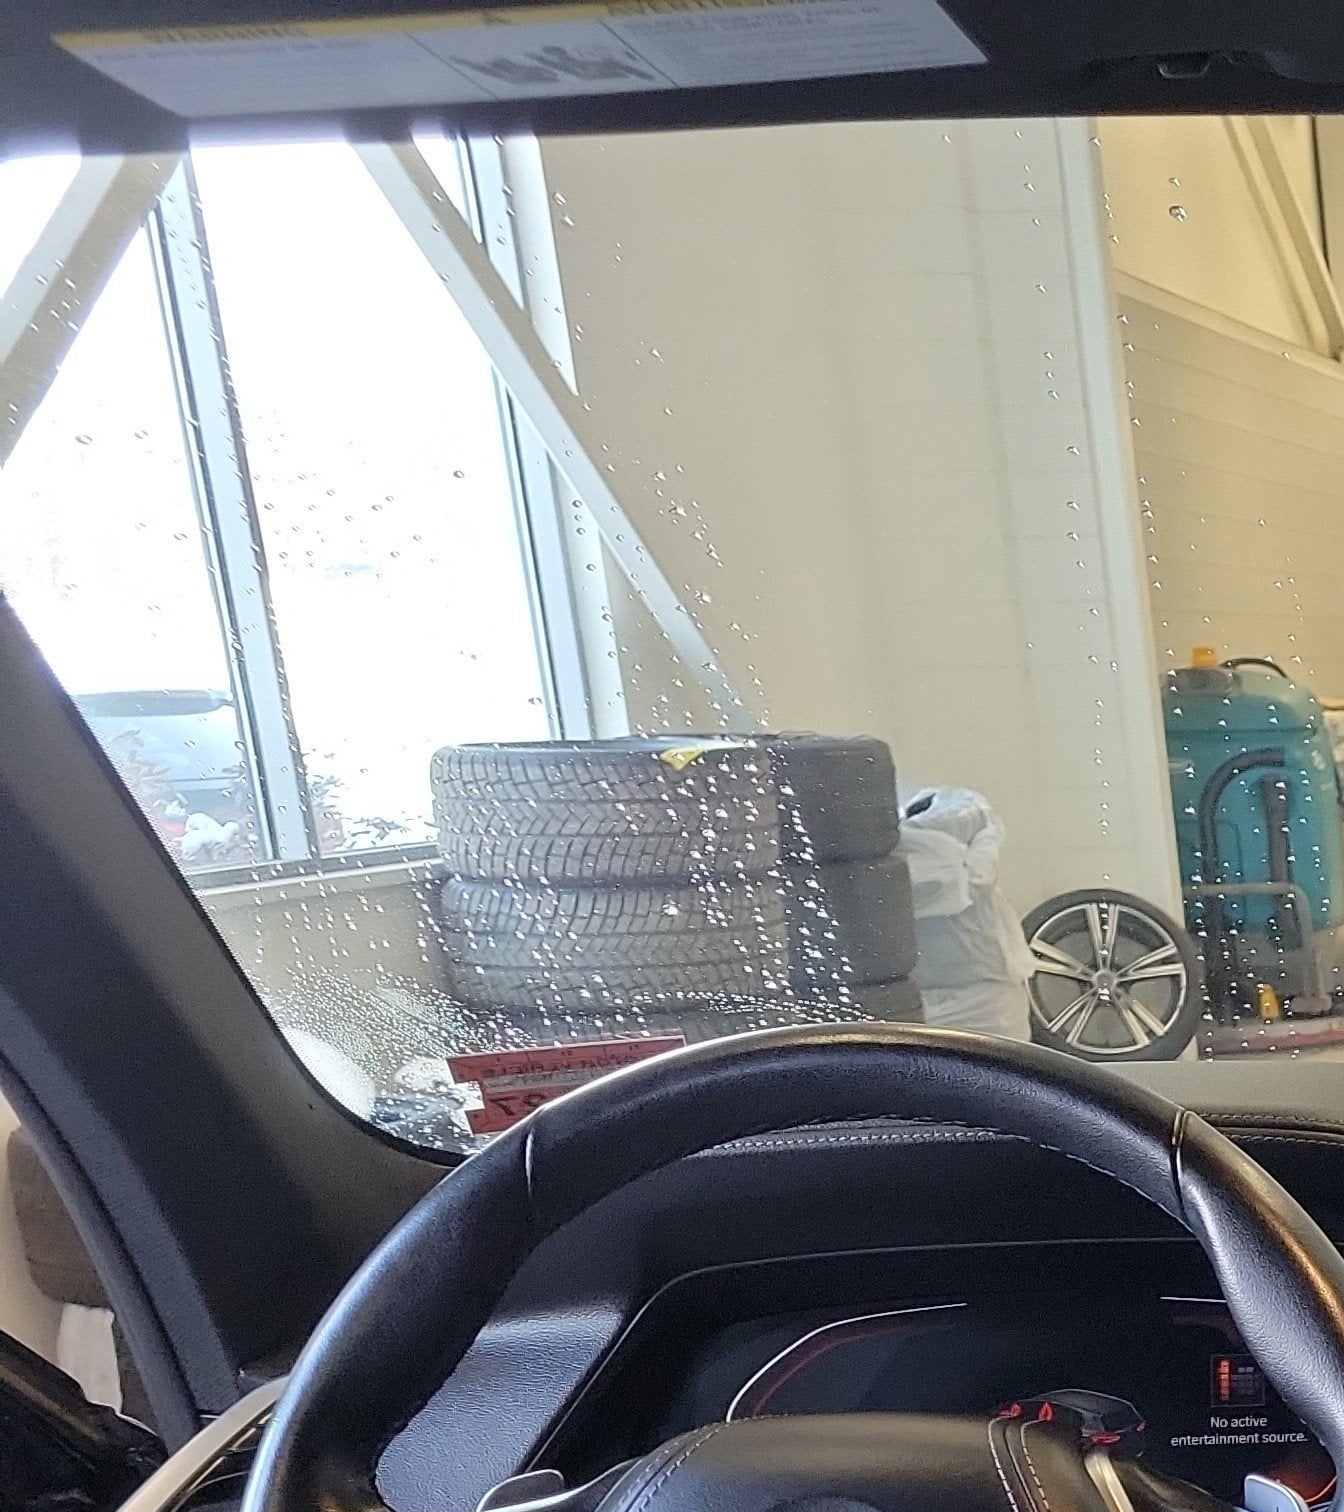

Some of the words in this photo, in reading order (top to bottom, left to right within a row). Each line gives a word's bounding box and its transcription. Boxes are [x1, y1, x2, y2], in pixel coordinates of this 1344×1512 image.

[1210, 1416, 1228, 1428] No
[1230, 1415, 1268, 1428] active
[1170, 1433, 1260, 1447] entertainment
[1261, 1432, 1308, 1443] source.
